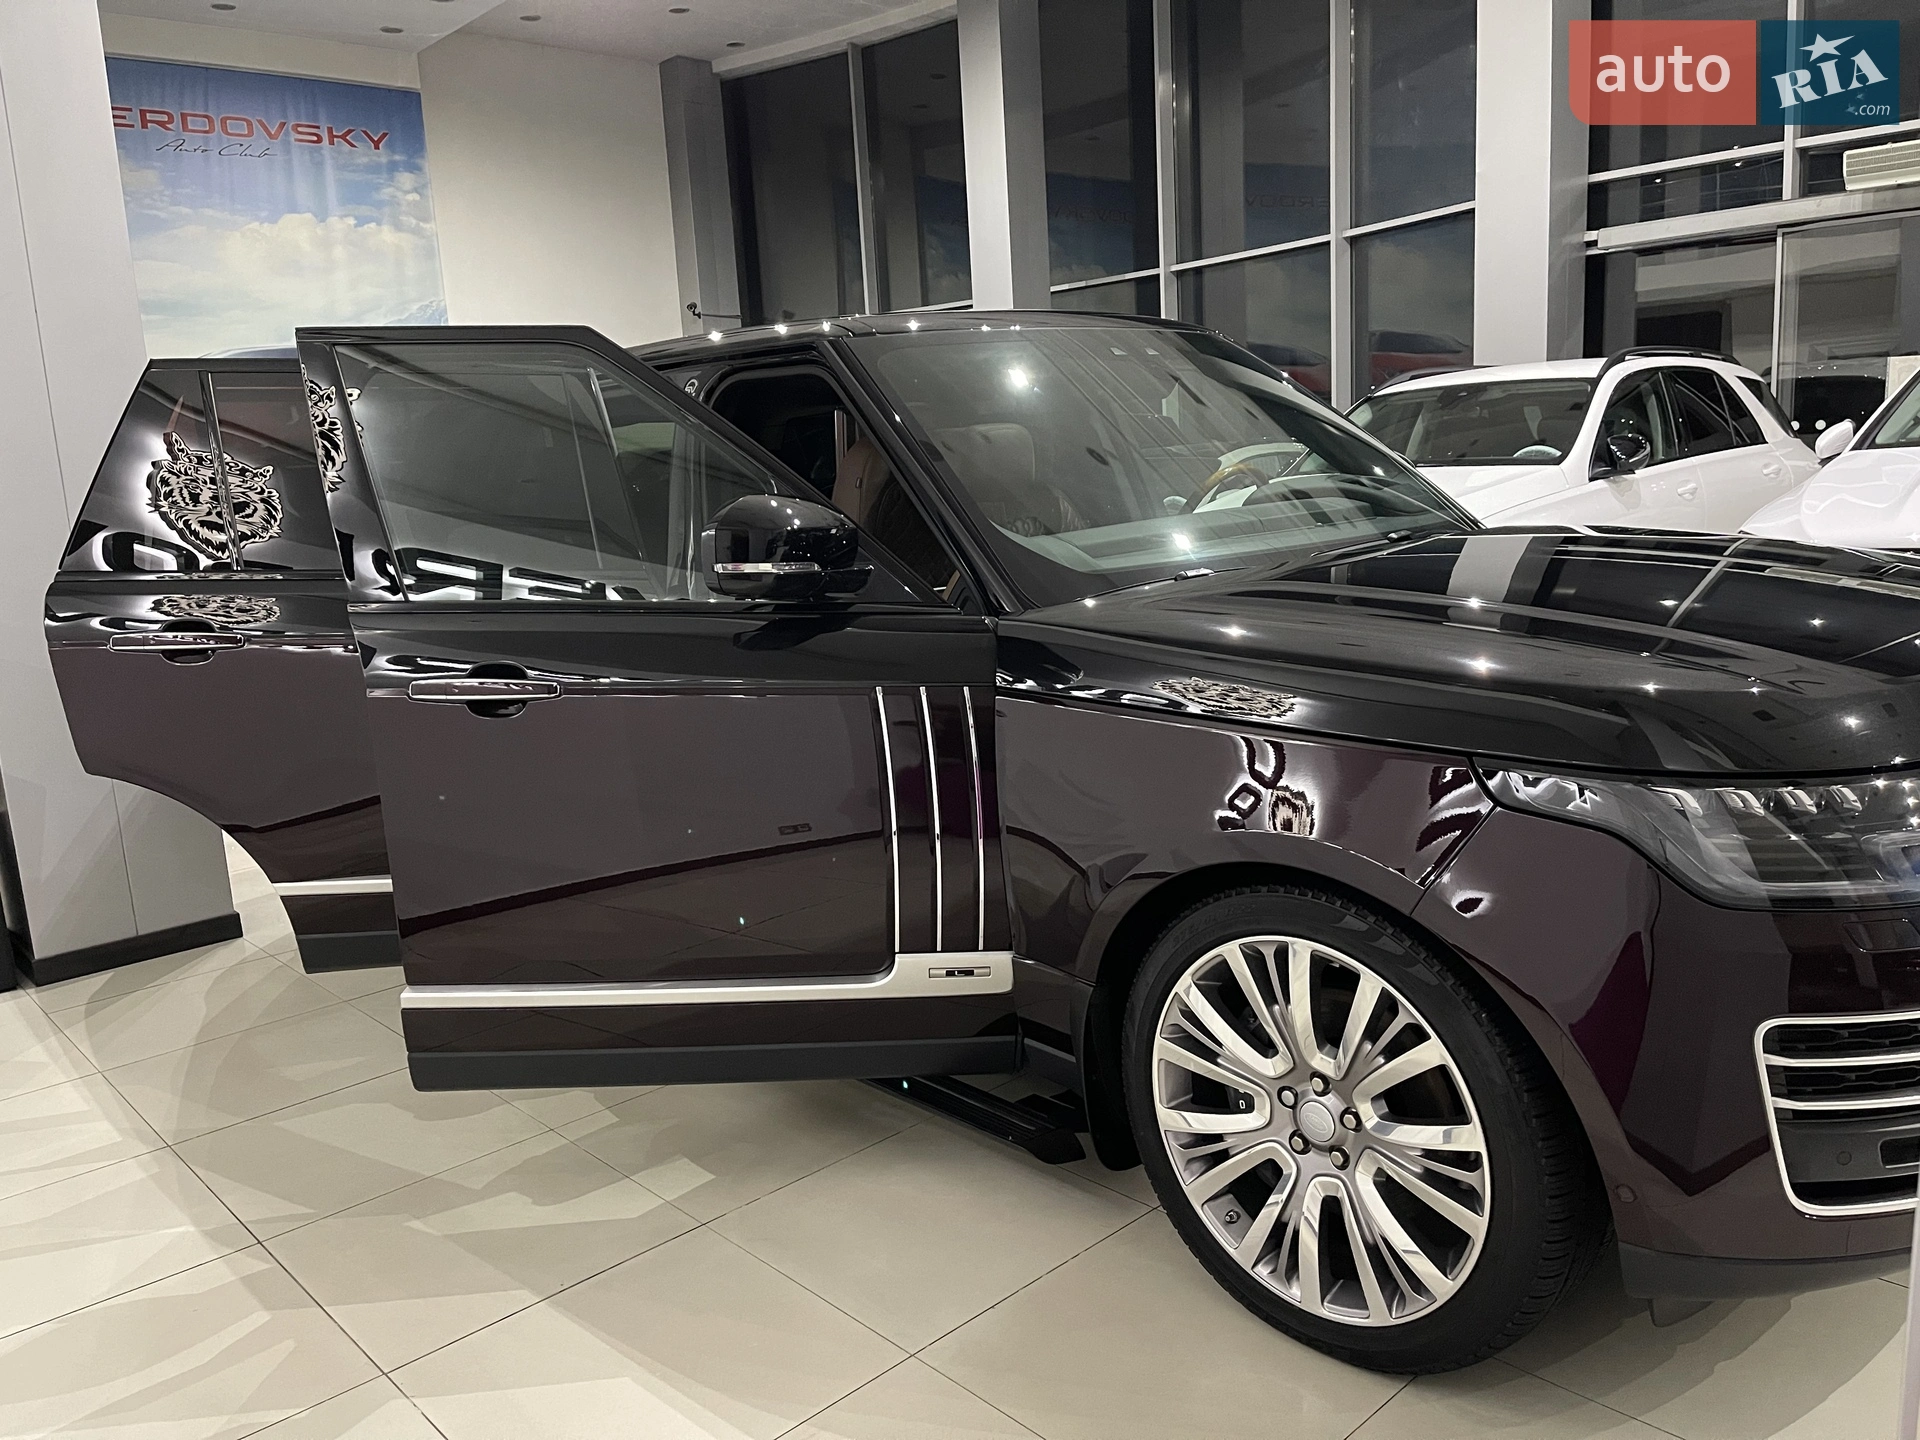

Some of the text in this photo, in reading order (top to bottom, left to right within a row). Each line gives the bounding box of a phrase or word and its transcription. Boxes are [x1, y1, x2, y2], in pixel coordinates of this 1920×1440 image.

[111, 105, 389, 150] ERDOVSKY
[155, 138, 278, 158] Auto Club
